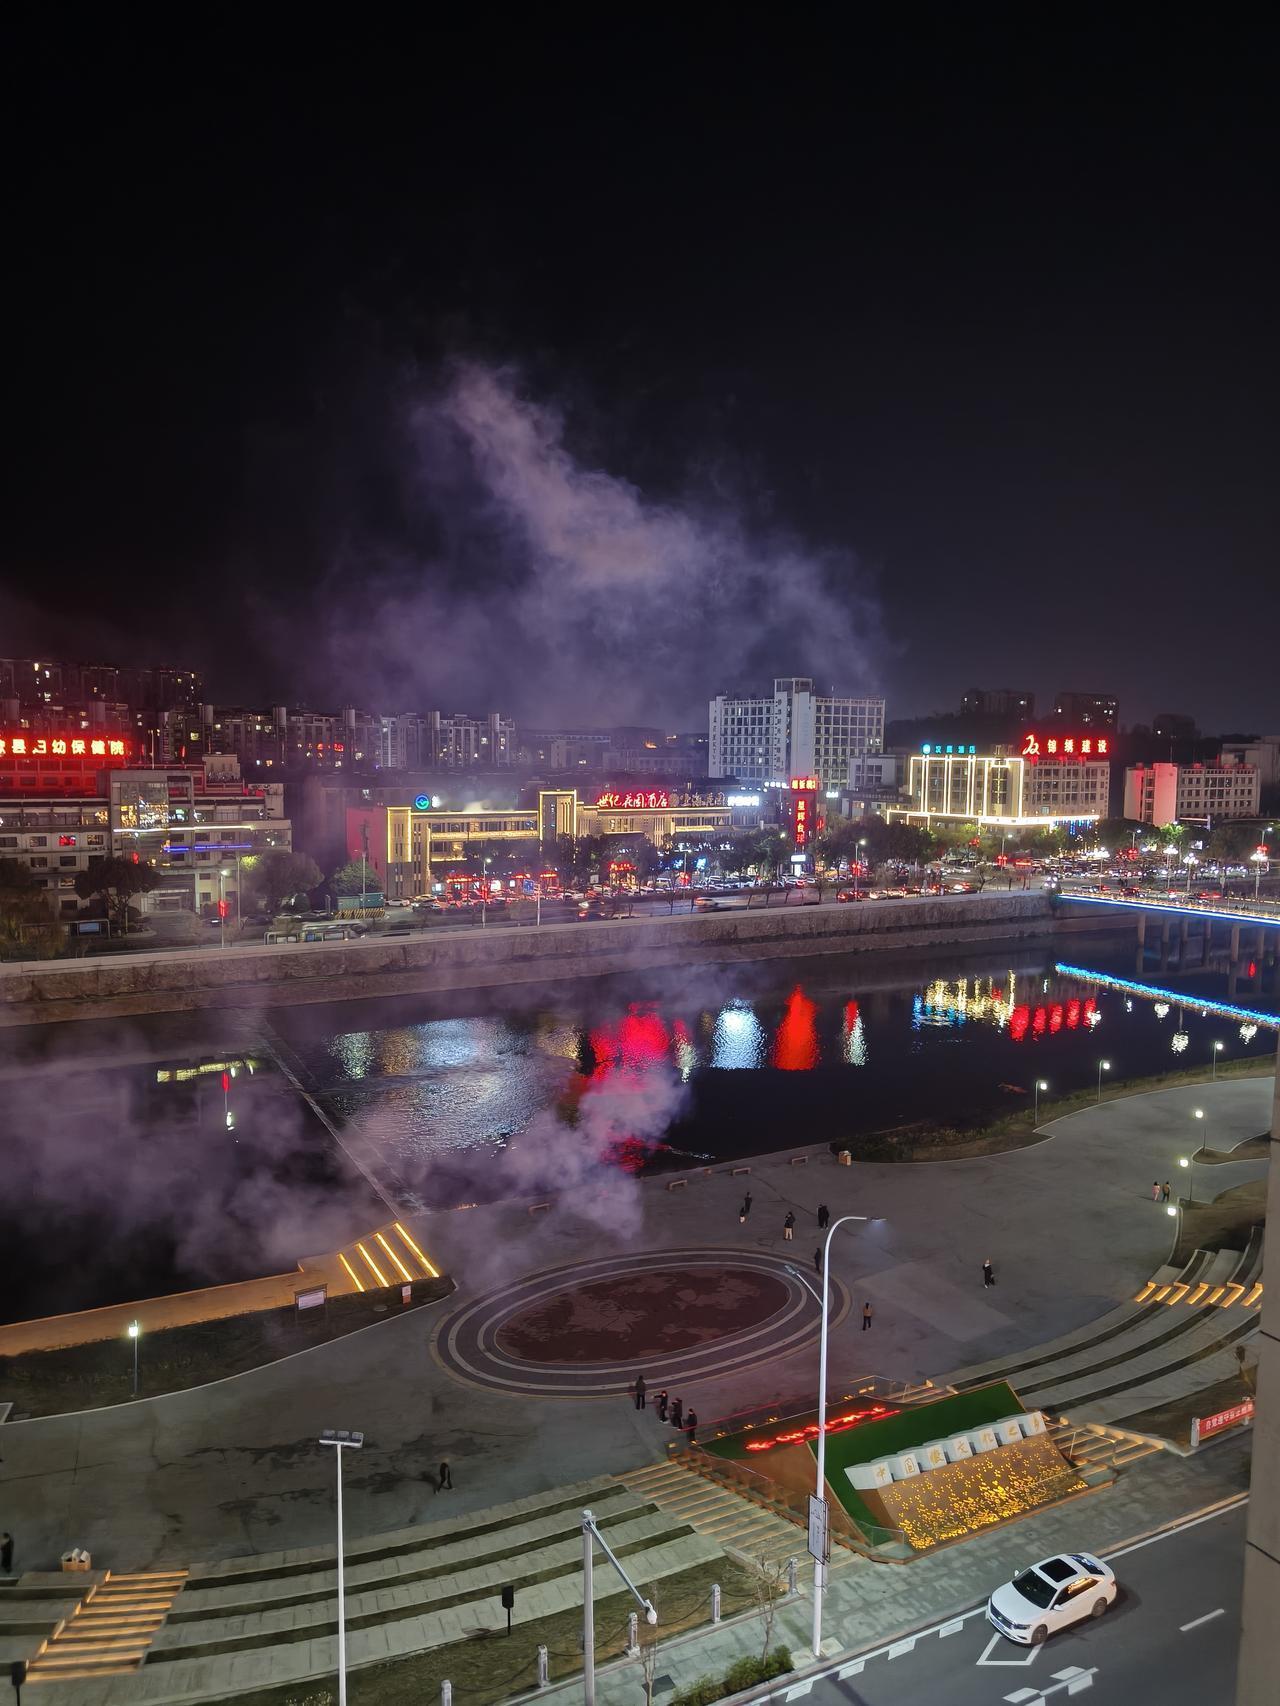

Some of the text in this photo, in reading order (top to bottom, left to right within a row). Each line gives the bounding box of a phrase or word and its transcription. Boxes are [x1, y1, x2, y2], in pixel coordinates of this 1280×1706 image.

[1047, 738, 1107, 754] 锦绣建设
[597, 791, 669, 808] 世纪花园酒店
